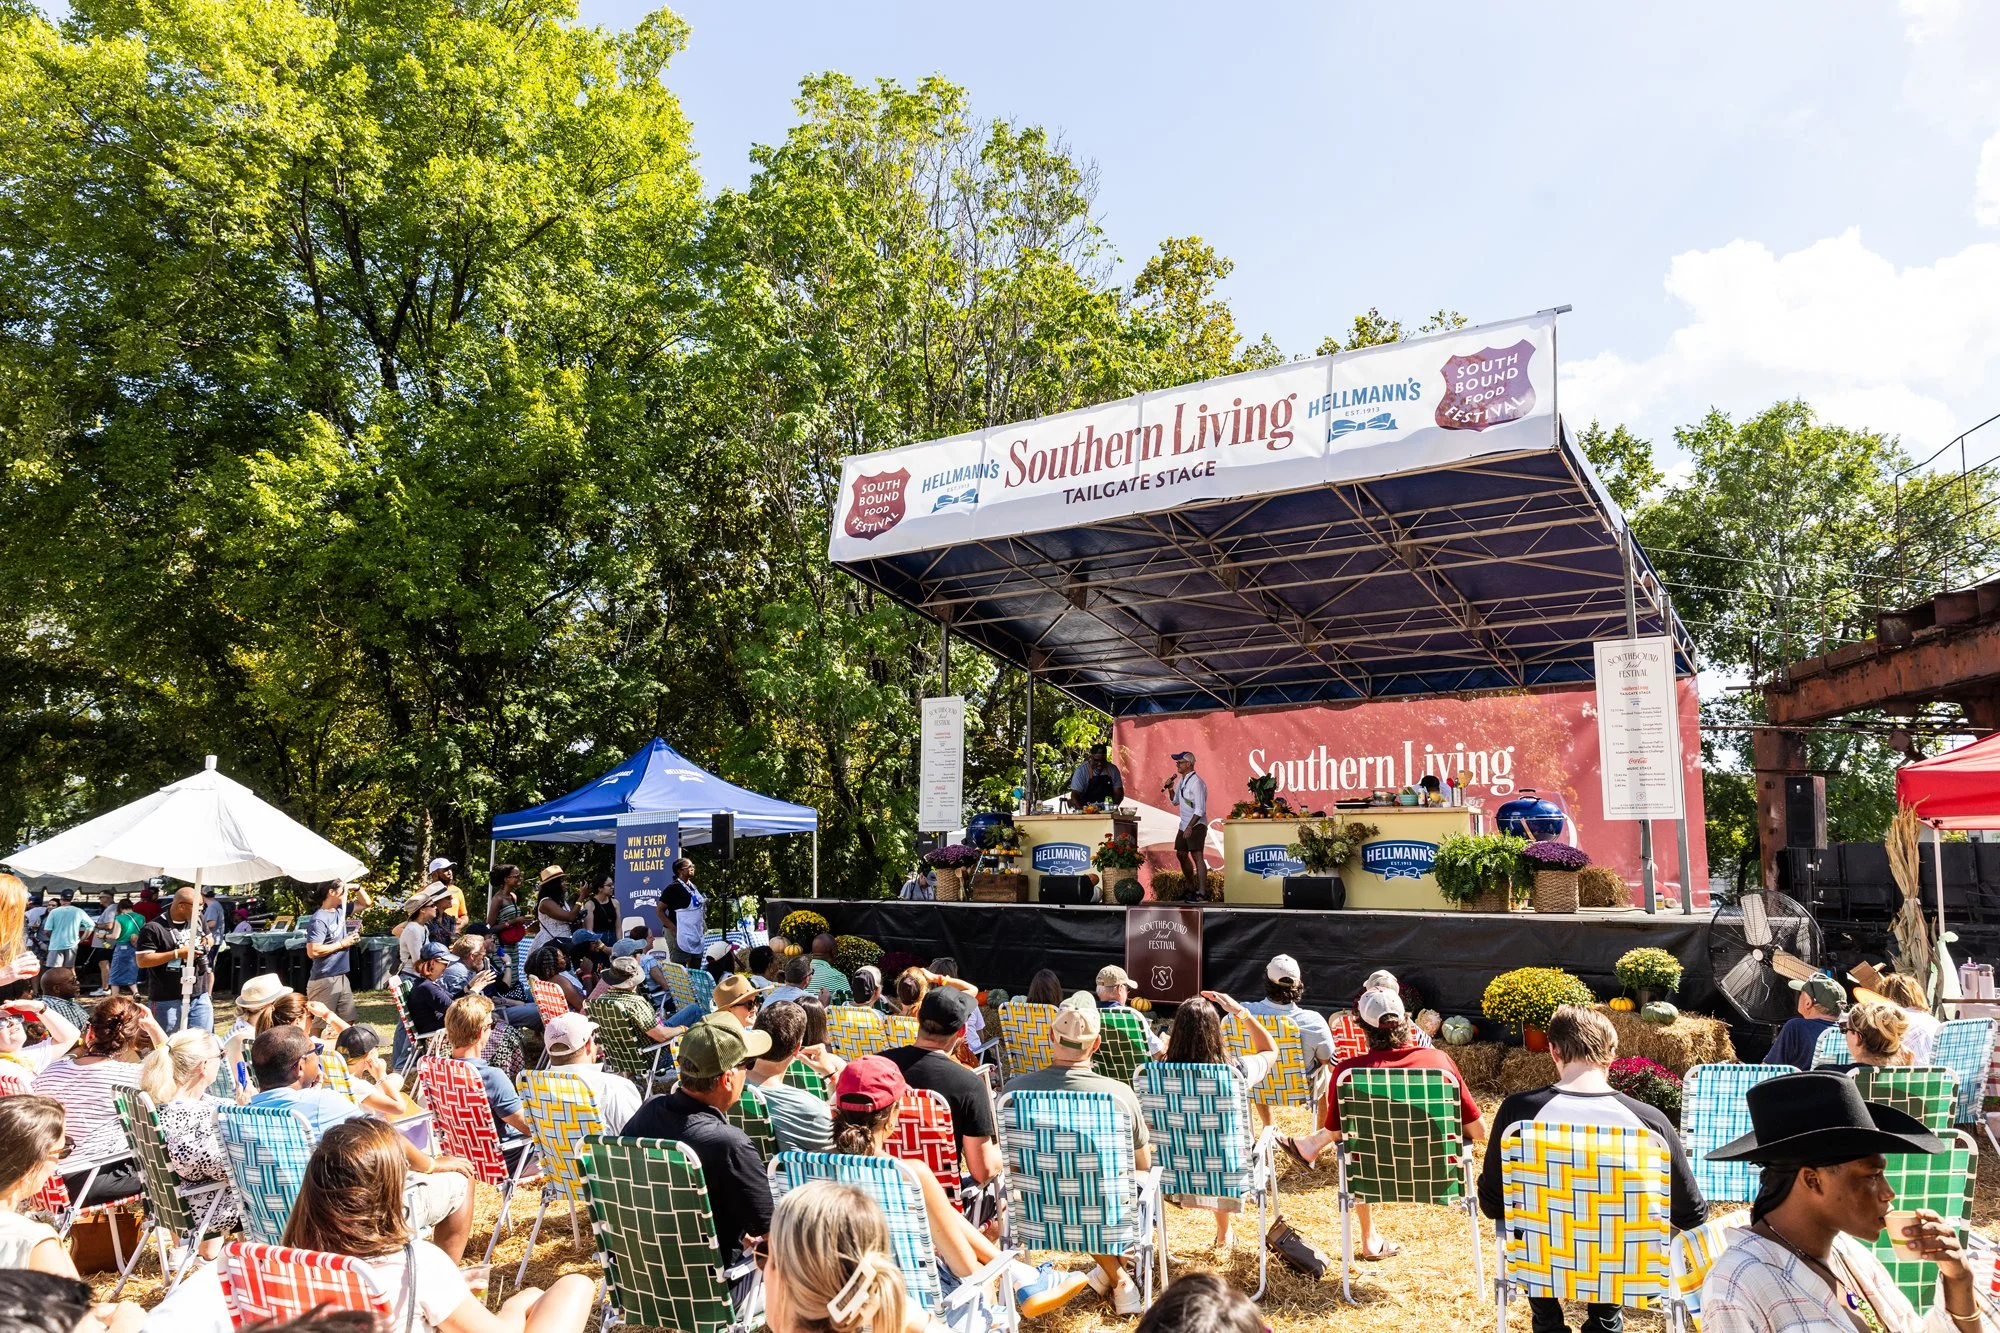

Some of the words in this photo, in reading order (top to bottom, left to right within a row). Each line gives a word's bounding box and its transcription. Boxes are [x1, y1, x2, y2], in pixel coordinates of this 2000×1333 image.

[1456, 352, 1518, 378] SOUTH
[1454, 366, 1519, 394] BOUND
[1308, 377, 1421, 418] HELLMANN'S
[1464, 386, 1505, 406] FOOD
[1444, 394, 1526, 425] FESTIVAL
[1004, 424, 1164, 488] Southern
[1170, 392, 1298, 451] Living
[922, 458, 1000, 494] HELLMANN'S
[1062, 473, 1150, 504] TAILGATE
[1156, 460, 1216, 488] STAGE
[861, 478, 900, 494] SOUTH
[859, 491, 900, 506] BOUND
[864, 506, 890, 517] FOOD
[850, 512, 900, 534] FESTIVAL
[1608, 652, 1659, 666] SOUTHBOUND
[1618, 670, 1648, 678] FESTIVAL
[1248, 746, 1396, 793] Southern
[1402, 740, 1515, 796] Living
[628, 836, 641, 846] WIN
[644, 834, 667, 846] EVERY
[624, 848, 644, 860] GAME
[647, 848, 662, 858] DAY
[664, 847, 671, 857] &
[1036, 847, 1087, 862] HELLMANN'S
[1367, 846, 1435, 863] HELLMANN'S
[630, 860, 664, 872] TAILGATE
[630, 888, 662, 899] HELLMANN'S
[1140, 920, 1188, 935] SOUTHBOUND
[1148, 940, 1176, 950] FESTIVAL
